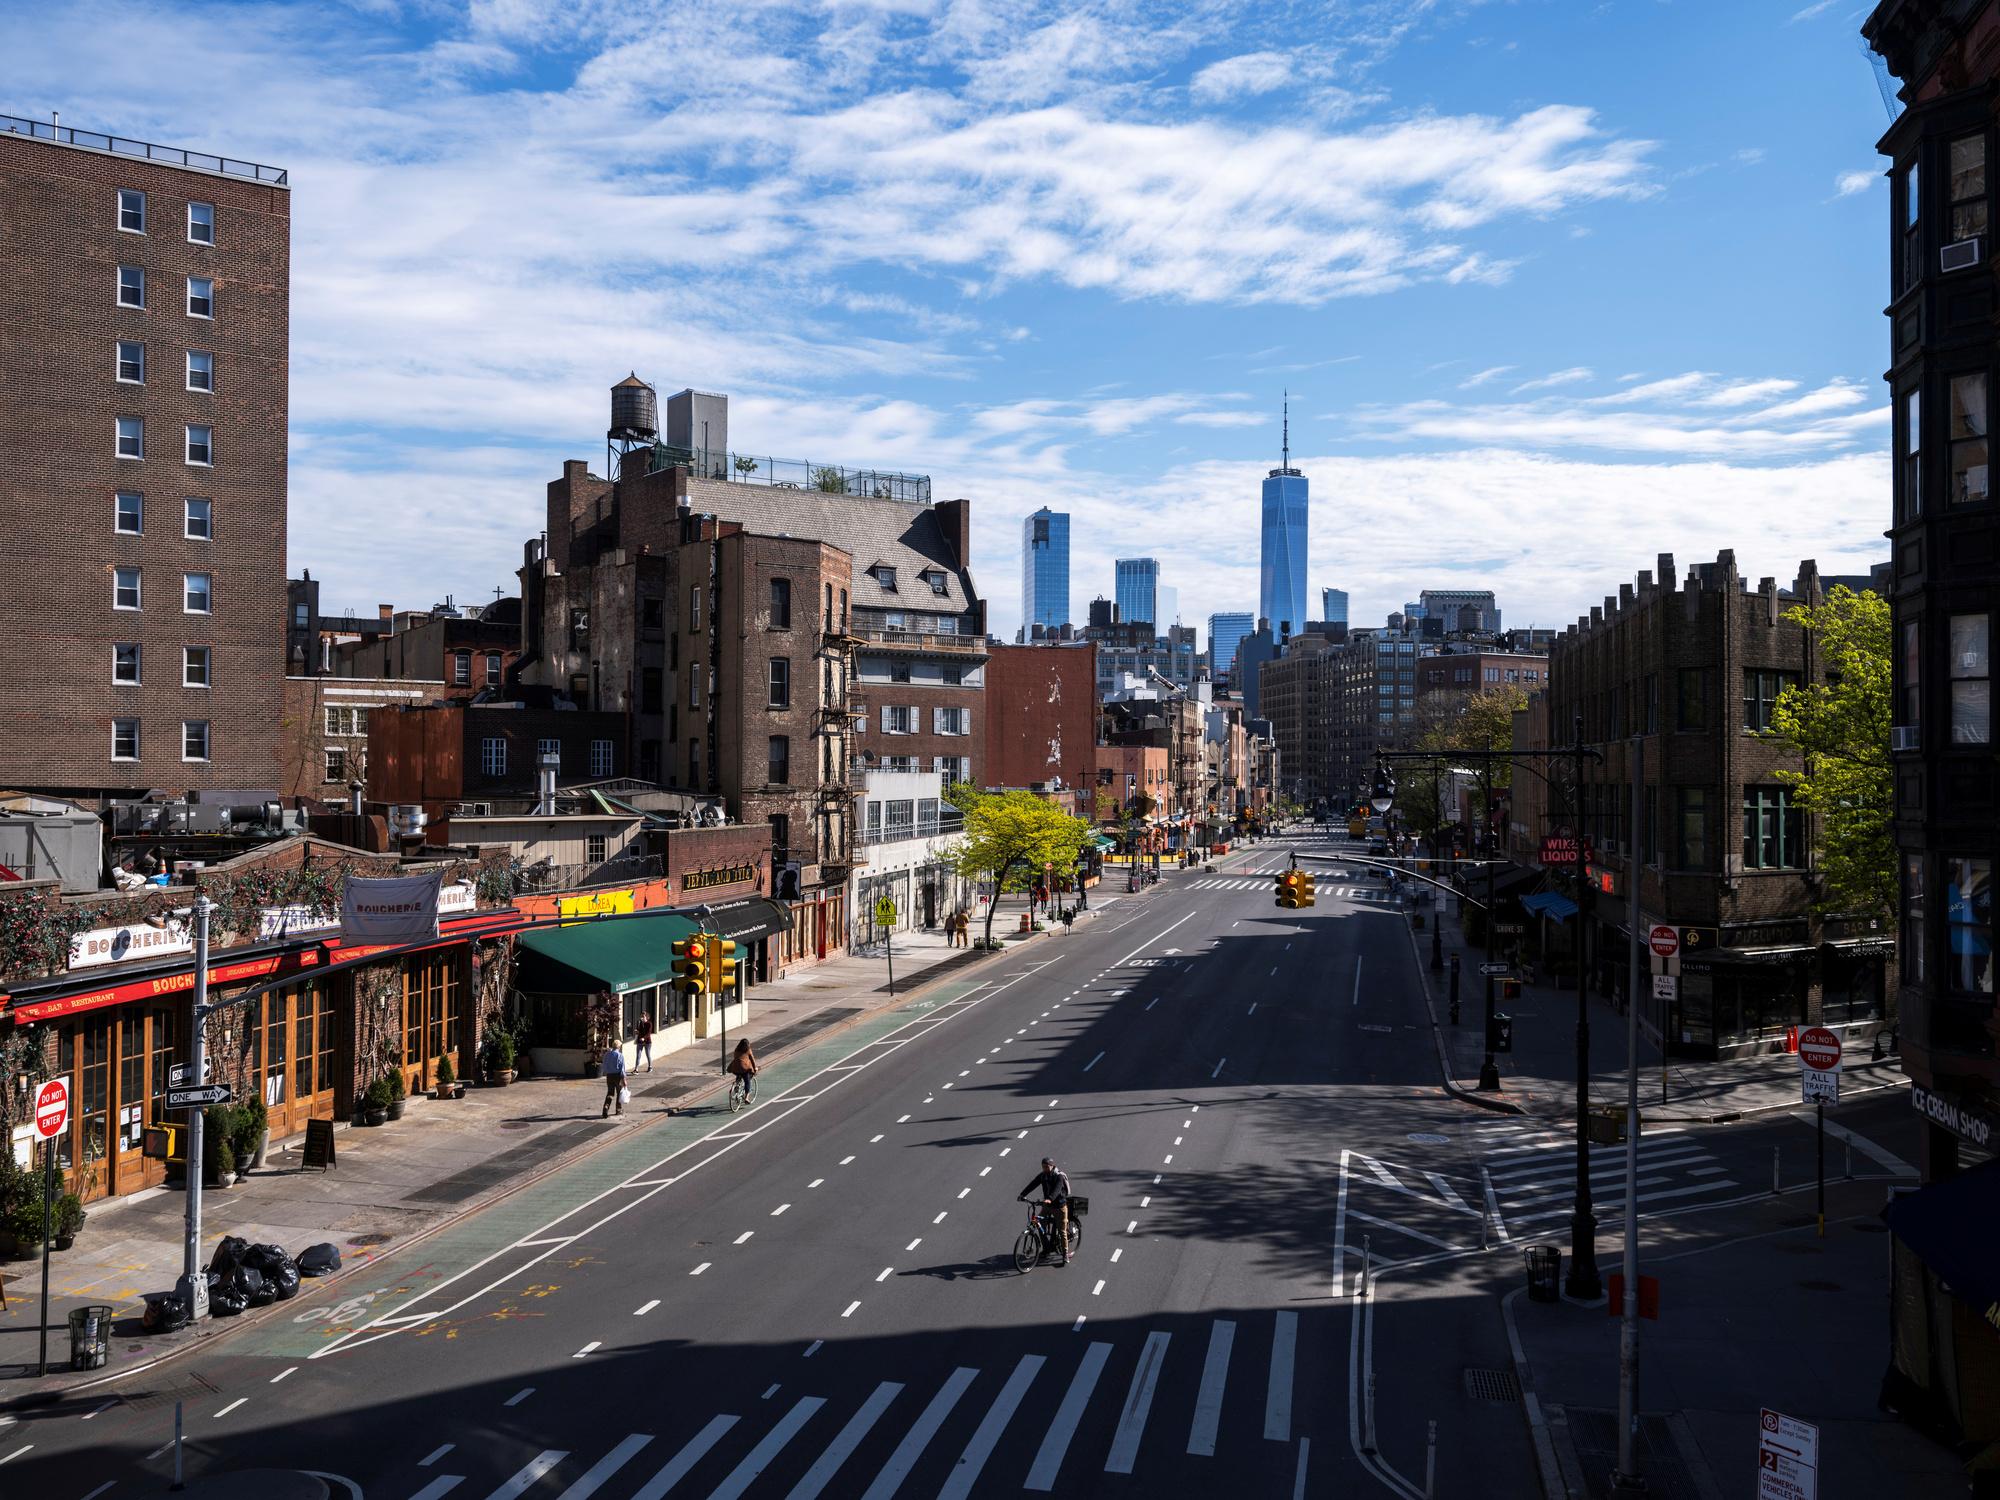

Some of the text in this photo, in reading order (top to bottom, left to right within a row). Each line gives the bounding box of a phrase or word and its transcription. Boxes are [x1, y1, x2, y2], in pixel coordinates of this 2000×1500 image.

[1543, 851, 1592, 862] LIQUOS
[439, 892, 467, 906] HERIE
[356, 902, 422, 913] BOUCHERIE
[87, 930, 177, 956] BOUCHERIE
[1656, 944, 1673, 952] ENTER
[47, 1003, 63, 1013] BAR
[71, 993, 115, 1008] RESTAURANT
[152, 970, 217, 993] BOUCHIE
[1805, 1035, 1834, 1045] DO NOT
[1807, 1053, 1833, 1063] ENTER
[1810, 1073, 1830, 1083] ALL
[1805, 1082, 1836, 1093] TRAFFIC
[41, 1089, 63, 1103] DO NOT
[171, 1090, 223, 1102] ONE WAY
[1912, 1086, 1989, 1145] ICE CREAM SHOP
[42, 1117, 61, 1129] ENTER
[121, 1139, 126, 1148] A
[1764, 1453, 1774, 1469] 2
[1762, 1473, 1804, 1495] COMMERCIAL
[1762, 1482, 1793, 1500] VEHICLES
